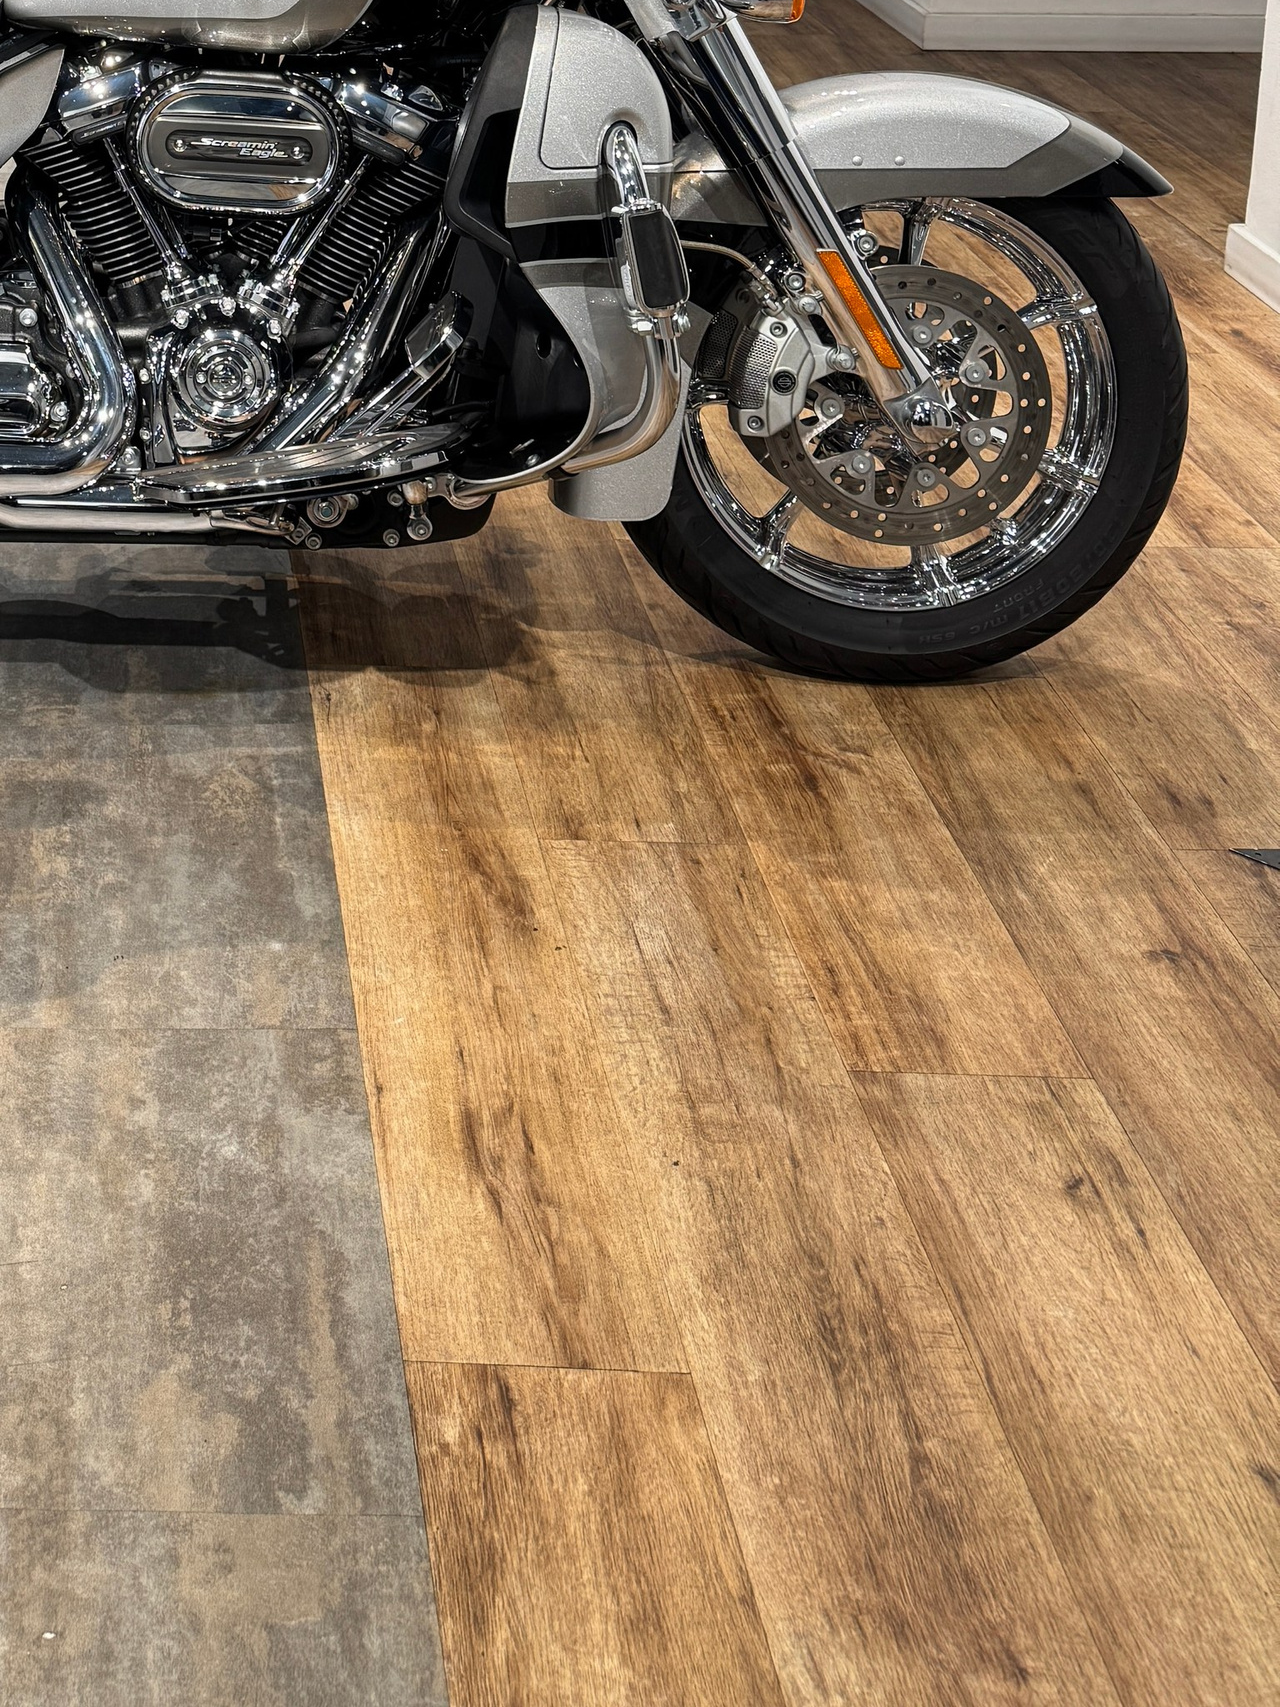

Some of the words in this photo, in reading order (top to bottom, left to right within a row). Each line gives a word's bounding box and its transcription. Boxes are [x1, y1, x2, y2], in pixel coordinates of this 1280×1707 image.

[190, 137, 278, 150] Screamin'
[239, 147, 288, 160] Eagle
[992, 579, 1045, 613] FRONT
